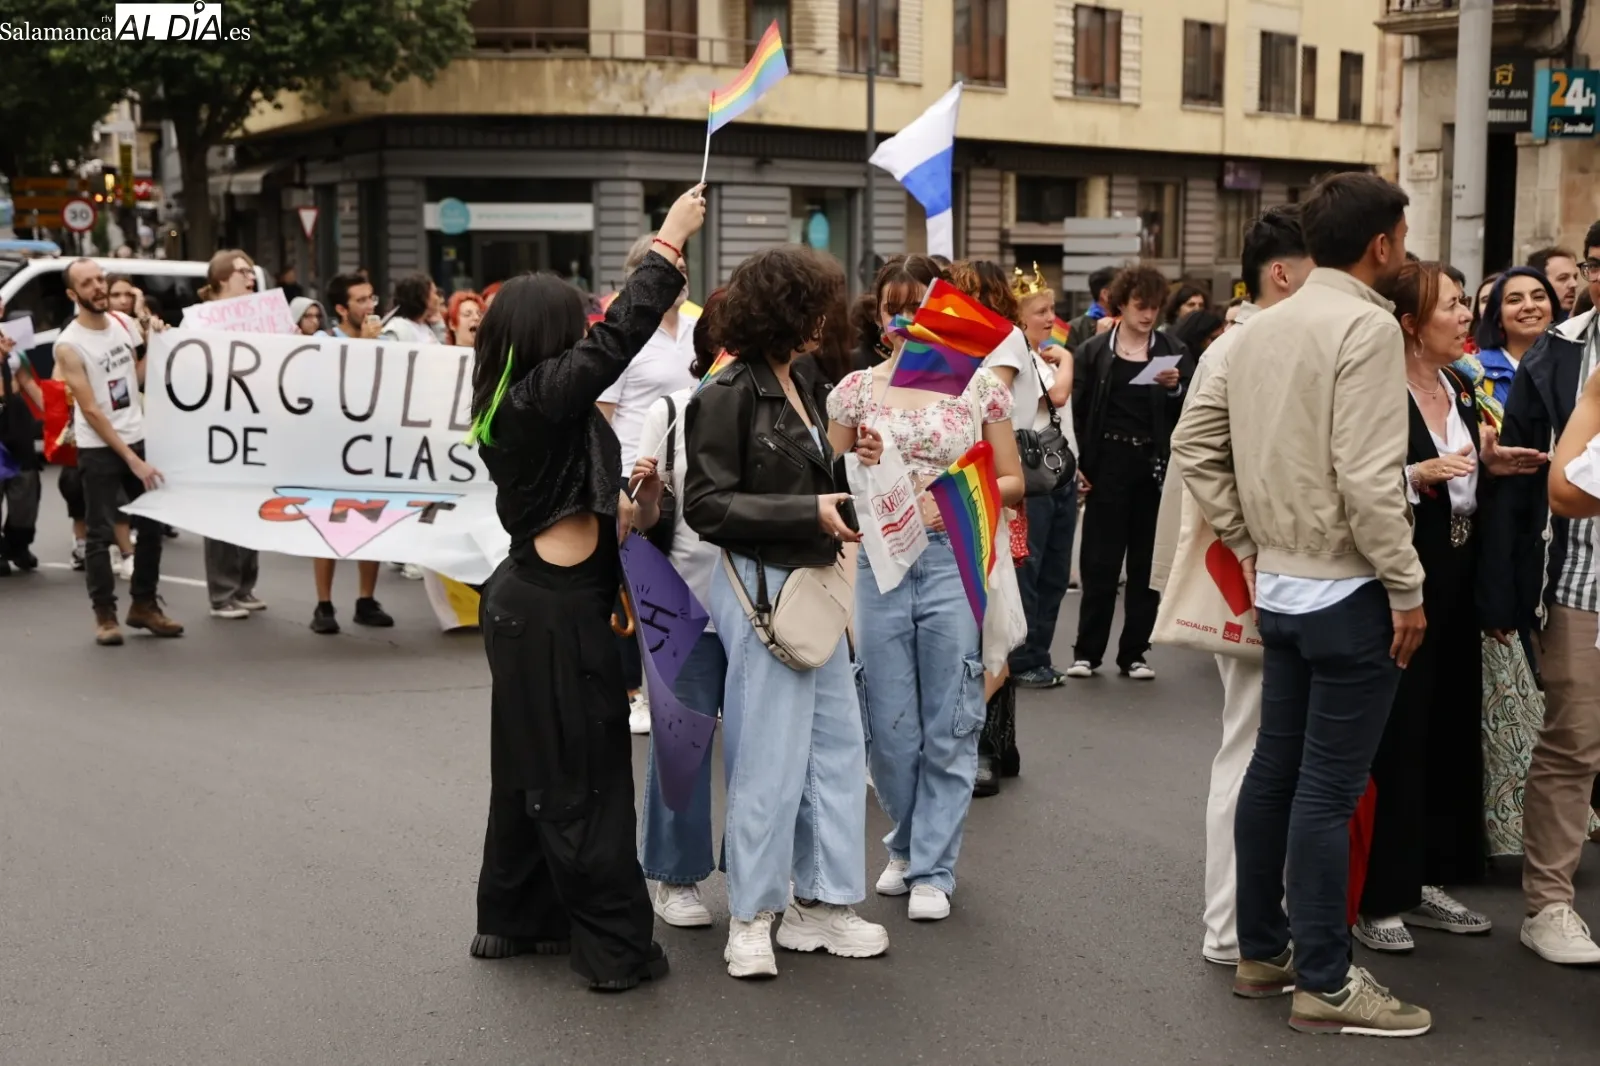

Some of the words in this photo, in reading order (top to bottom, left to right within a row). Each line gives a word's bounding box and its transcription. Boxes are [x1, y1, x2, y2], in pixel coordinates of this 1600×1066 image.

[1550, 71, 1596, 115] 24h
[69, 208, 90, 223] 30
[164, 337, 474, 432] ORGULL
[208, 425, 268, 467] DE
[341, 434, 494, 483] CLAS
[258, 496, 457, 525] CNT
[1175, 618, 1218, 634] SOCIALISTS
